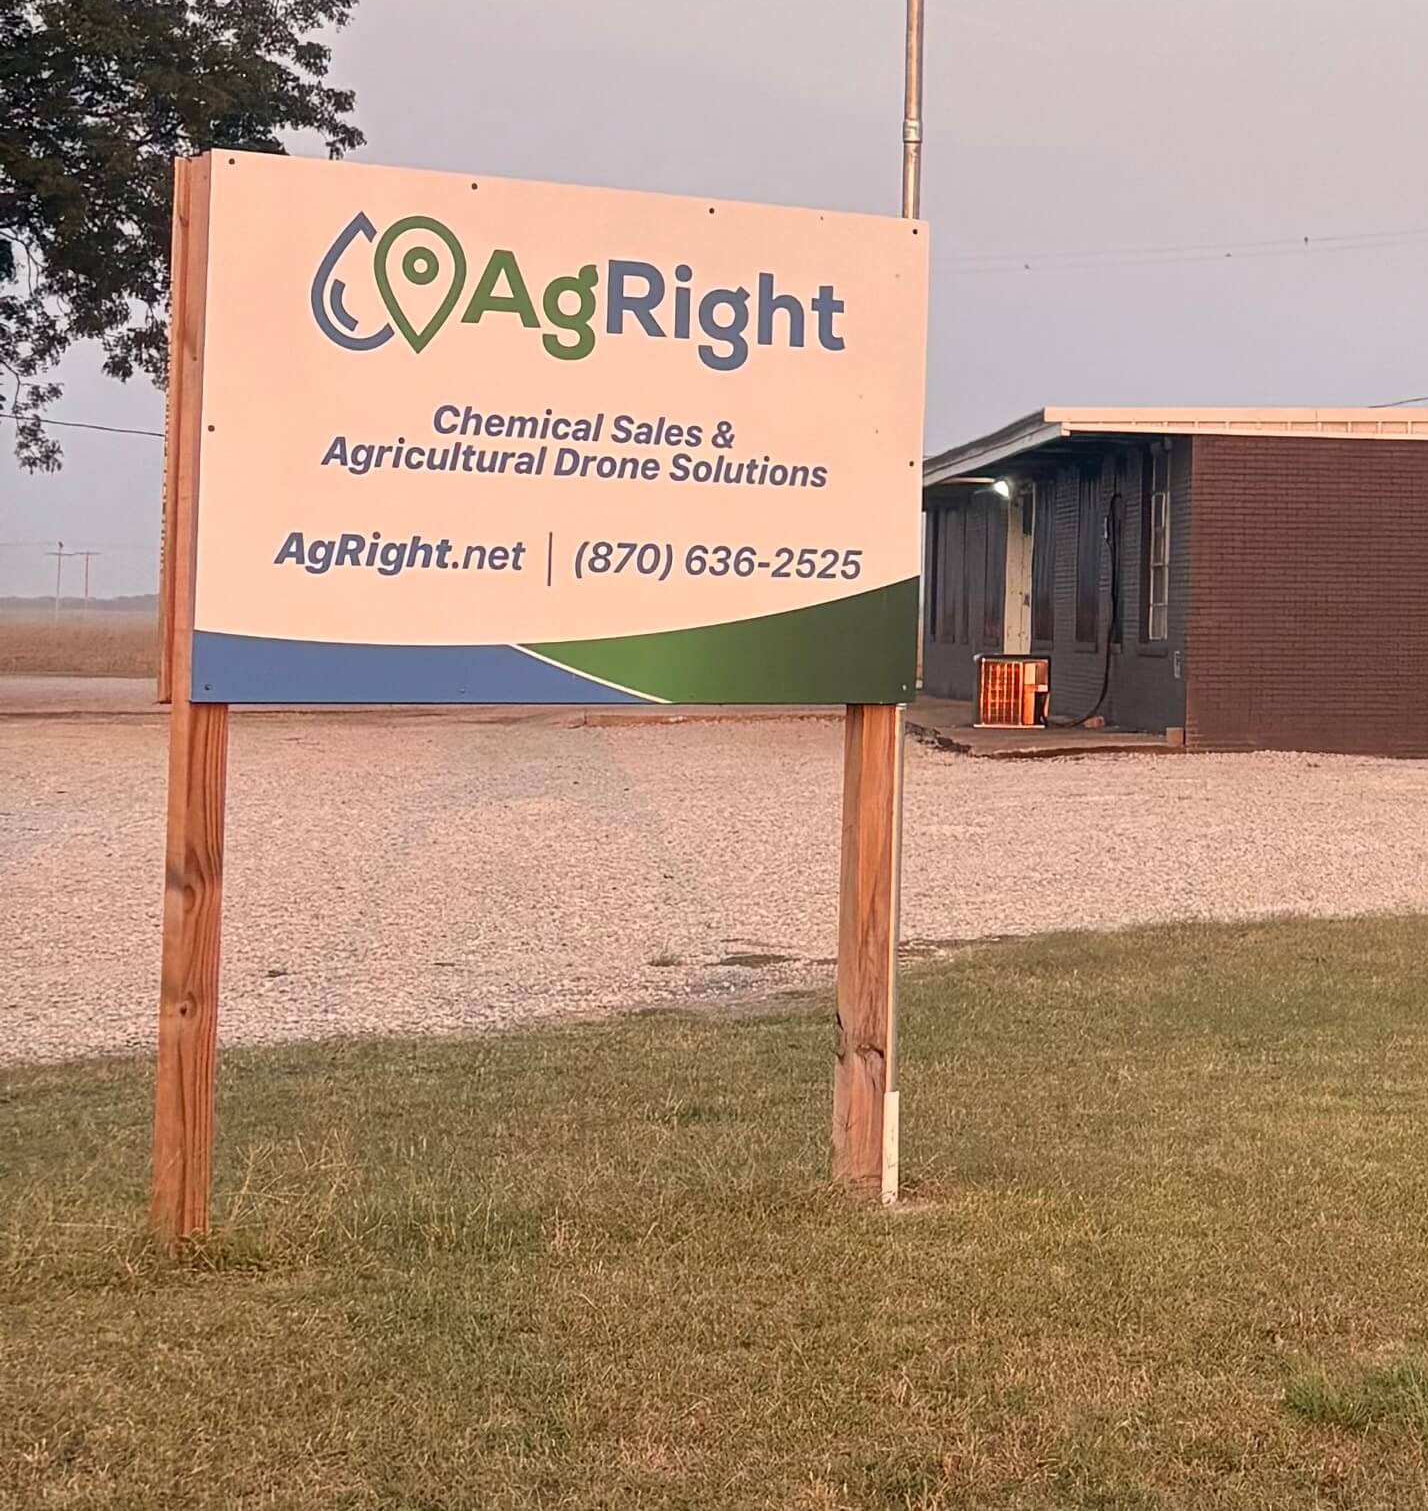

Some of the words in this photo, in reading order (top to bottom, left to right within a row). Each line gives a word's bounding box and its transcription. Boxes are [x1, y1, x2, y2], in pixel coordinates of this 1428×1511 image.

[460, 249, 846, 372] AgRight
[433, 404, 605, 442] Chemical
[610, 414, 703, 448] Sales
[711, 420, 735, 449] &
[320, 436, 548, 476] Agricultural
[553, 447, 661, 481] Drone
[668, 452, 828, 488] Solutions
[273, 531, 527, 577] AgRight.net
[574, 541, 673, 582] (870)
[685, 544, 863, 580] 636-2525
